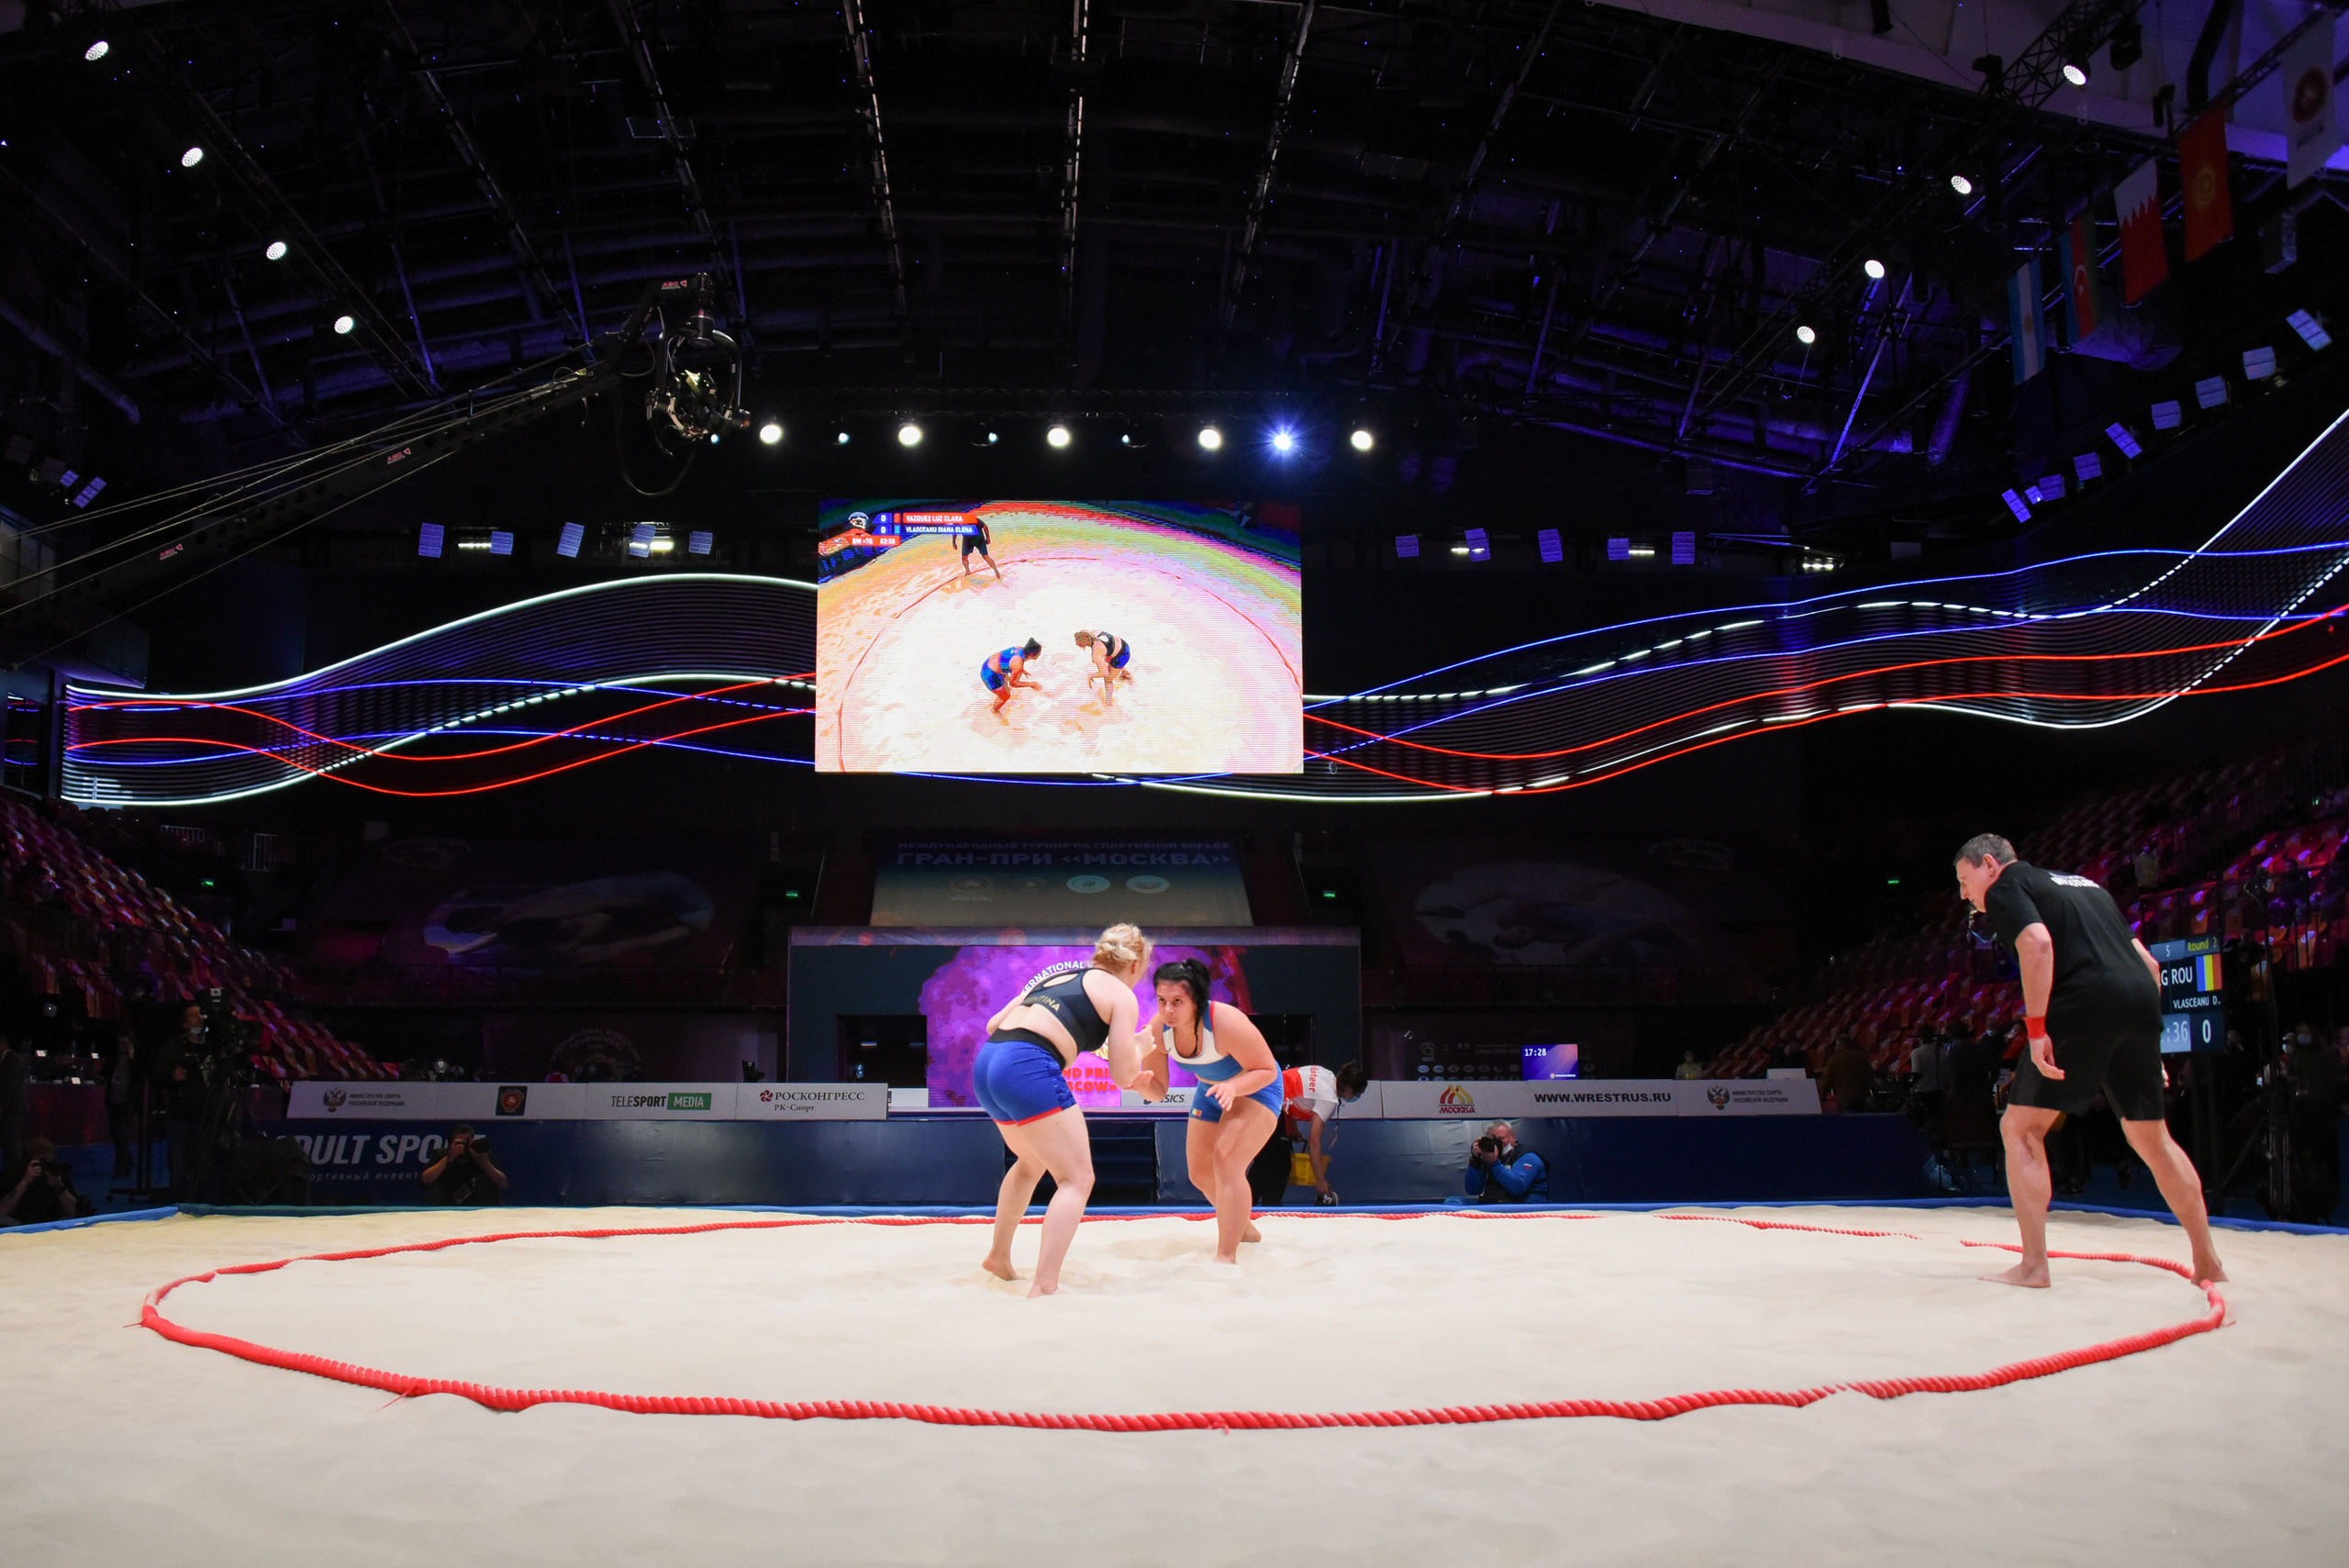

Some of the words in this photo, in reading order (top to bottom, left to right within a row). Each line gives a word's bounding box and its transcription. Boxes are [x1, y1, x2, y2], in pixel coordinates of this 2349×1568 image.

[897, 841, 1019, 850] МЕЖДУНАРОДНЫЙ
[896, 853, 1052, 865] ГРАН-ПРИ
[1062, 853, 1230, 865] «МОСКВА»
[2188, 938, 2209, 951] Round
[2212, 937, 2217, 949] 2
[2165, 945, 2170, 957] 5
[2171, 966, 2193, 984] ROU
[2173, 996, 2210, 1009] VLASCEANU
[2212, 995, 2221, 1006] D.
[2202, 1019, 2211, 1043] 0
[1524, 1048, 1547, 1056] 17:28
[1085, 1067, 1112, 1078] PRI
[611, 1095, 667, 1107] TELESPORT
[674, 1095, 704, 1107] MEDIA
[775, 1092, 865, 1101] РОСКОНГРЕСС
[1534, 1093, 1672, 1103] WWW.WRESTRUS.RU
[774, 1104, 815, 1112] РК-Спорт
[309, 1173, 370, 1182] ортивный
[376, 1173, 419, 1181] инвент
